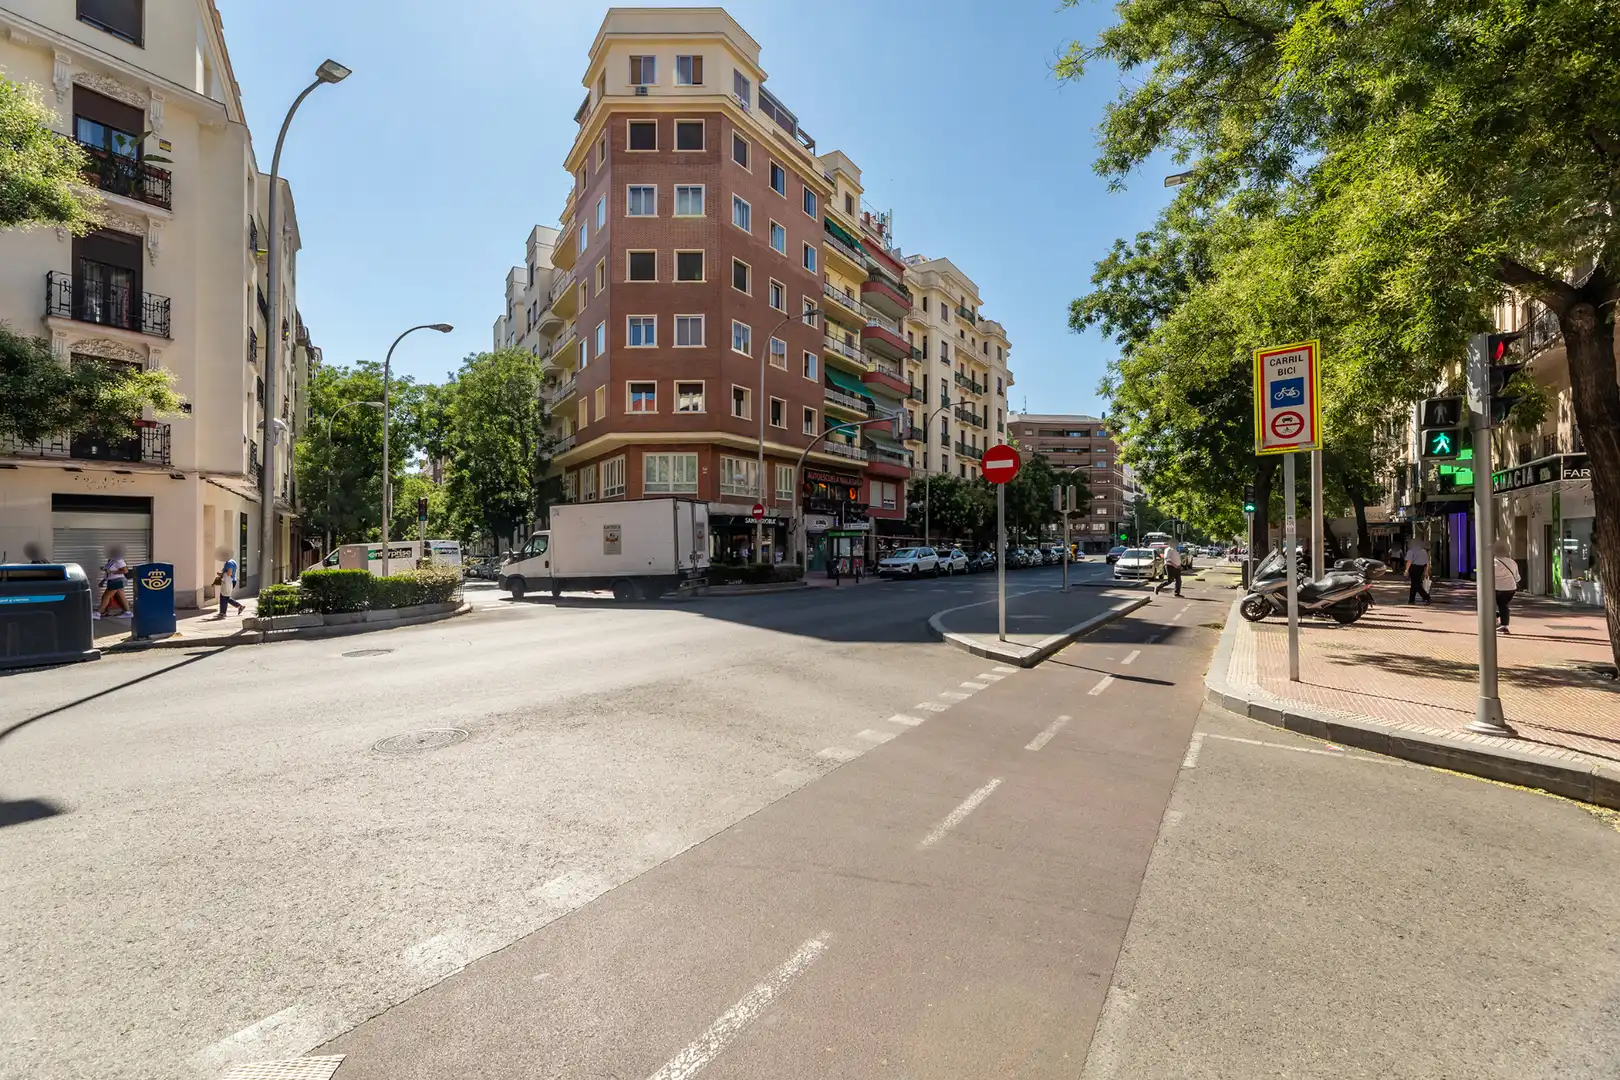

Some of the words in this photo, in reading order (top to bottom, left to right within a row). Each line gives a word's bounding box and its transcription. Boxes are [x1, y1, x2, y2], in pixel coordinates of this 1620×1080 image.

[1269, 354, 1304, 367] CARRIL
[1277, 366, 1296, 377] BICI
[1492, 466, 1534, 492] RMACIA
[1563, 468, 1591, 478] FAR
[367, 548, 412, 561] entrprise
